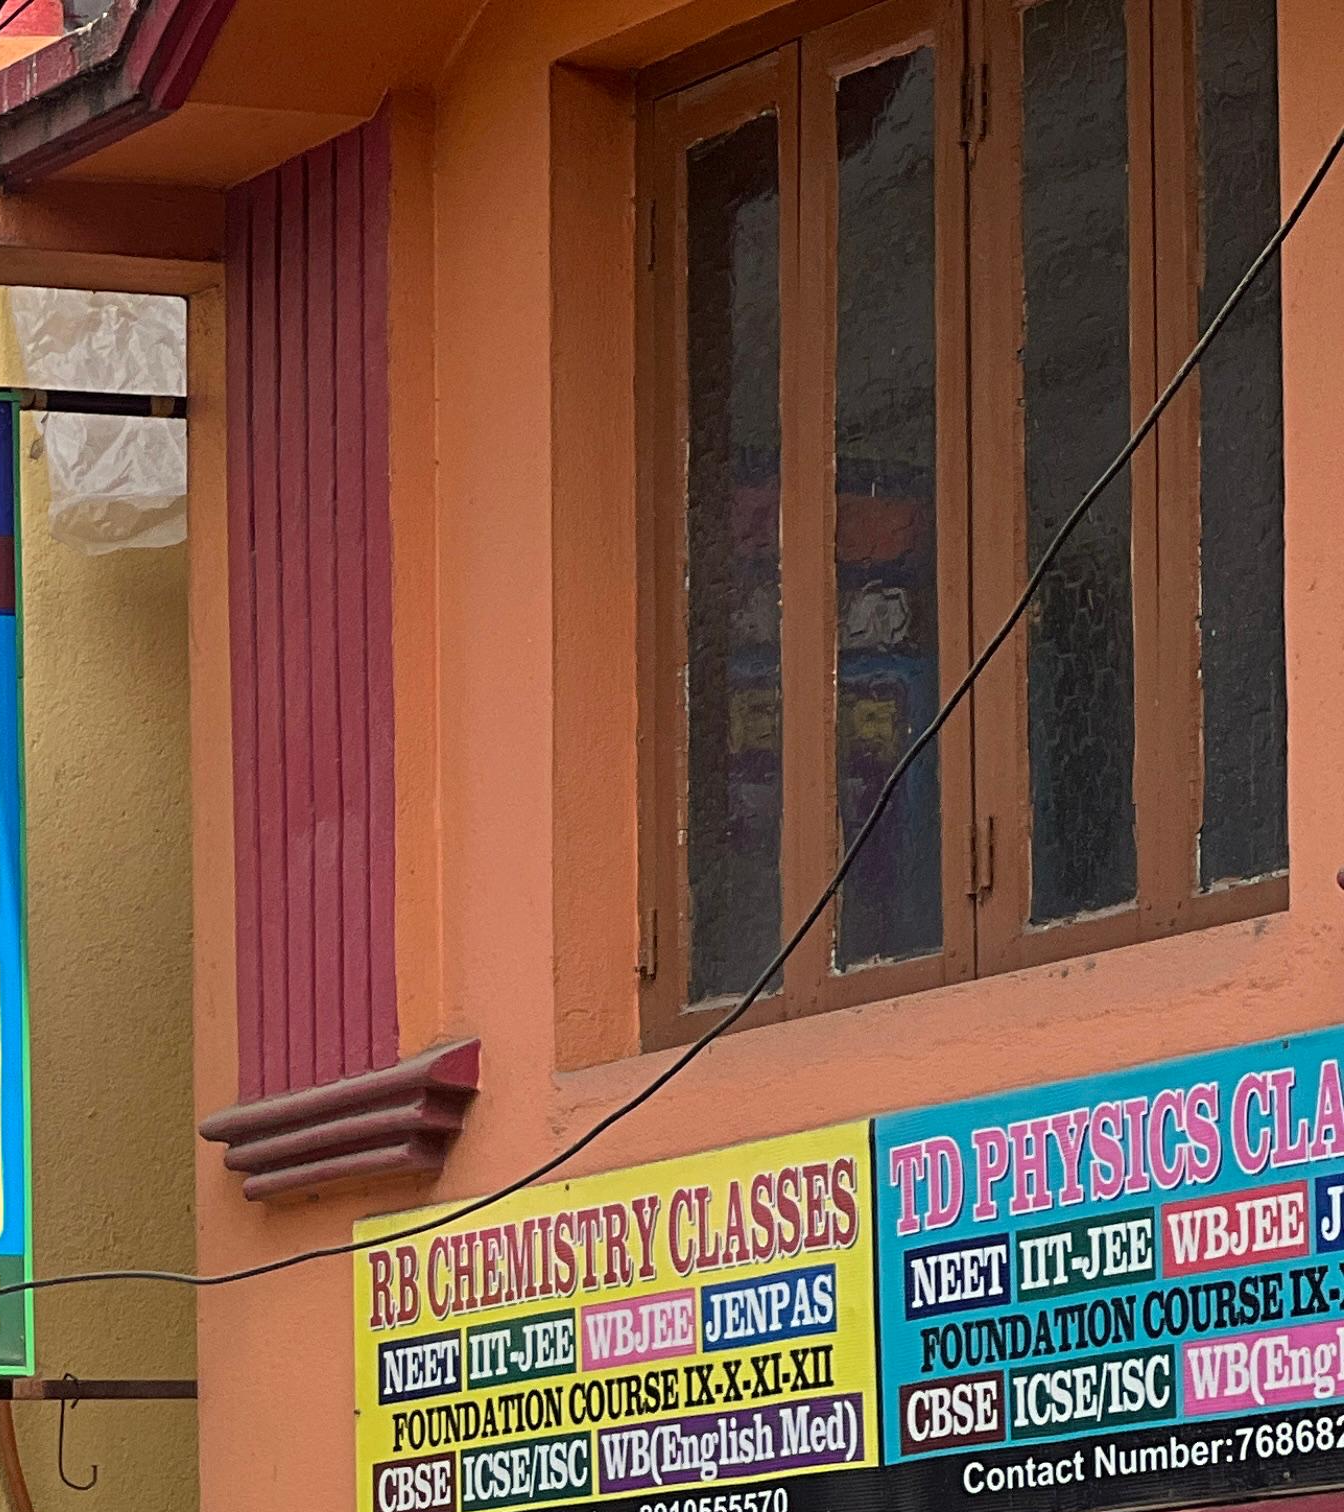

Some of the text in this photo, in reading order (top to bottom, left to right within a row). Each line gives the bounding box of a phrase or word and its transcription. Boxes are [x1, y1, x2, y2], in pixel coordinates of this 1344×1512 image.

[889, 1134, 962, 1237] TD
[970, 1081, 1221, 1223] PHYSICS
[368, 1157, 859, 1330] RB CHEMISTRY CLASSES
[910, 1243, 1007, 1309] NEET
[1019, 1218, 1154, 1291] IIT-JEE
[1167, 1191, 1305, 1266] WBJEE
[383, 1274, 835, 1395] NEET IIT-JEE WBJEE JENPAS
[920, 1262, 1344, 1373] FOUNDATION COURSE IX-
[392, 1345, 834, 1452] FOUNDATION COURSE IX-X-XI-XII
[462, 1438, 589, 1501] ICSE/ISC
[600, 1413, 774, 1484] WB(English
[779, 1399, 859, 1462] Med)
[906, 1380, 998, 1443] CBSE
[1013, 1353, 1170, 1428] ICSE/ISC
[963, 1454, 1085, 1494] Contact
